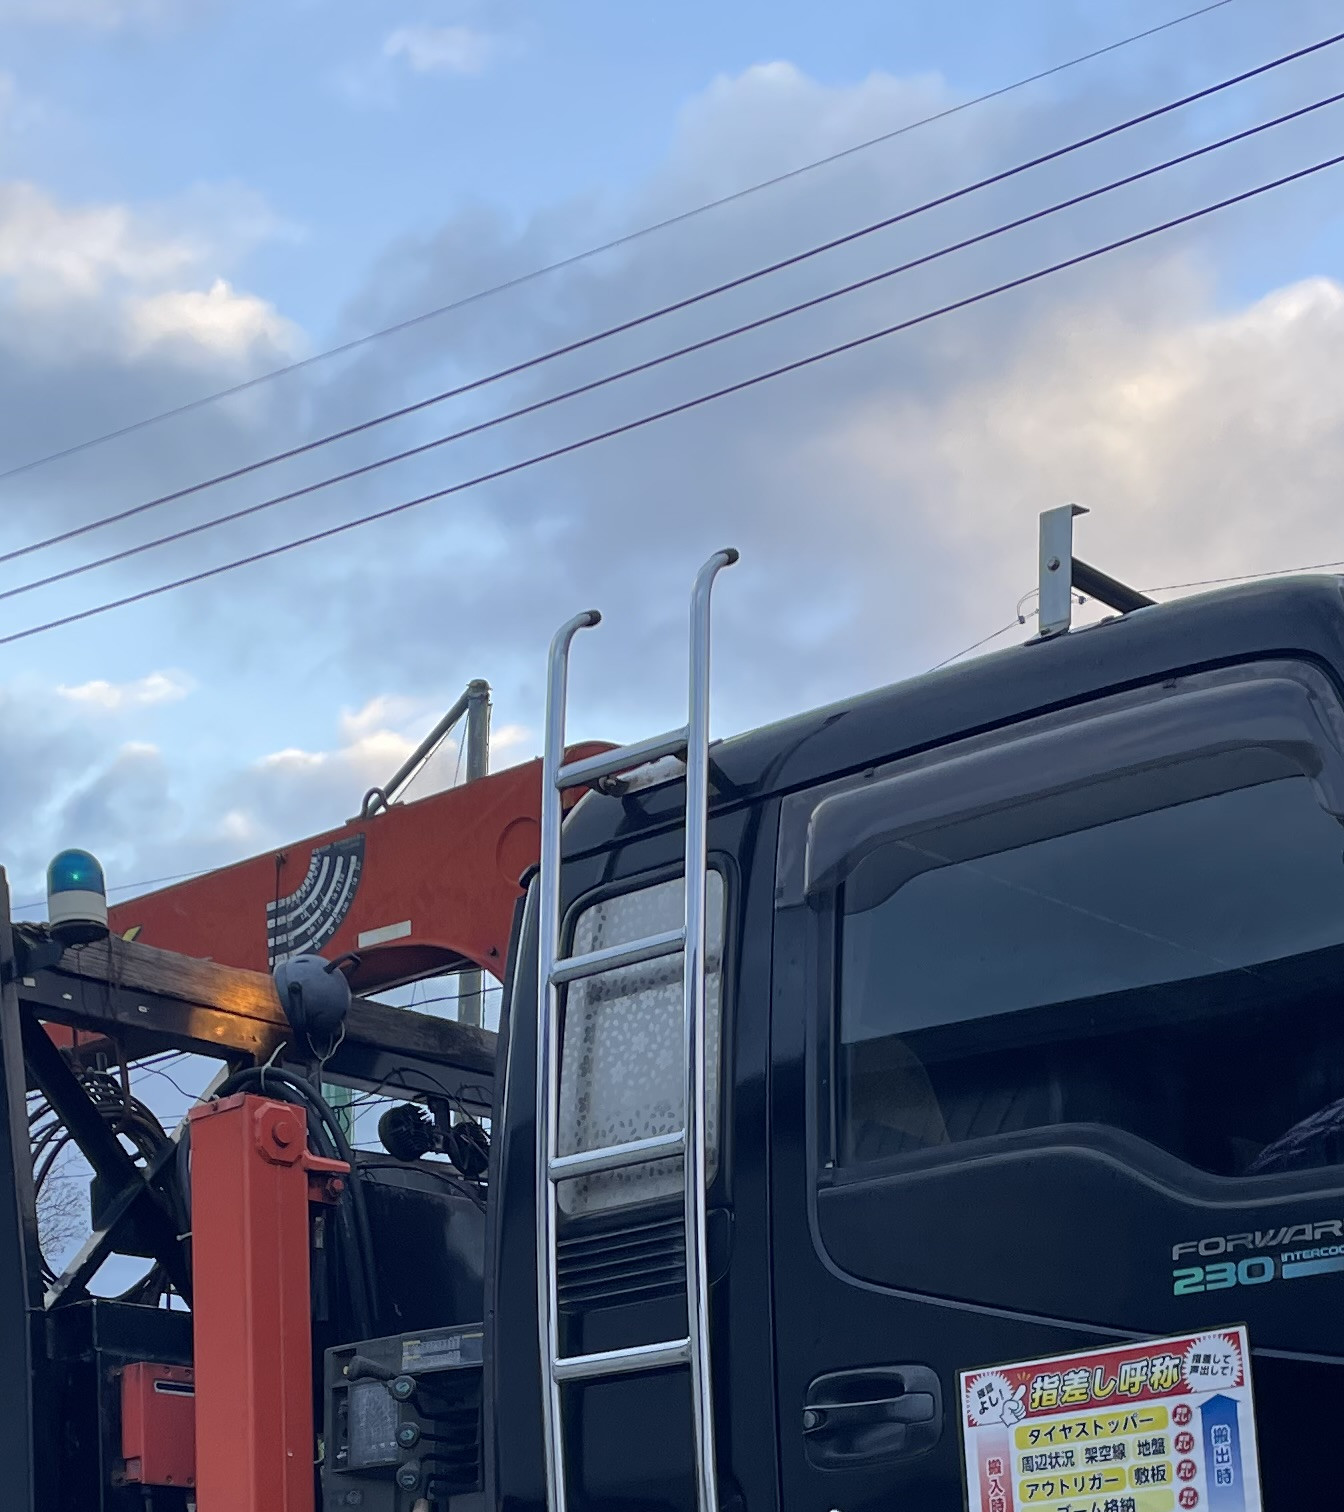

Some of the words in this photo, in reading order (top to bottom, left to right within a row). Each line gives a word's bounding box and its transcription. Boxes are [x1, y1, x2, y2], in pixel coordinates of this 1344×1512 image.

[1173, 1256, 1275, 1296] 230
[1030, 1354, 1182, 1410] 指差し呼称
[1028, 1412, 1154, 1445] タイヤストッパー
[1084, 1443, 1127, 1464] 架空線
[1025, 1472, 1119, 1499] アウトリガー
